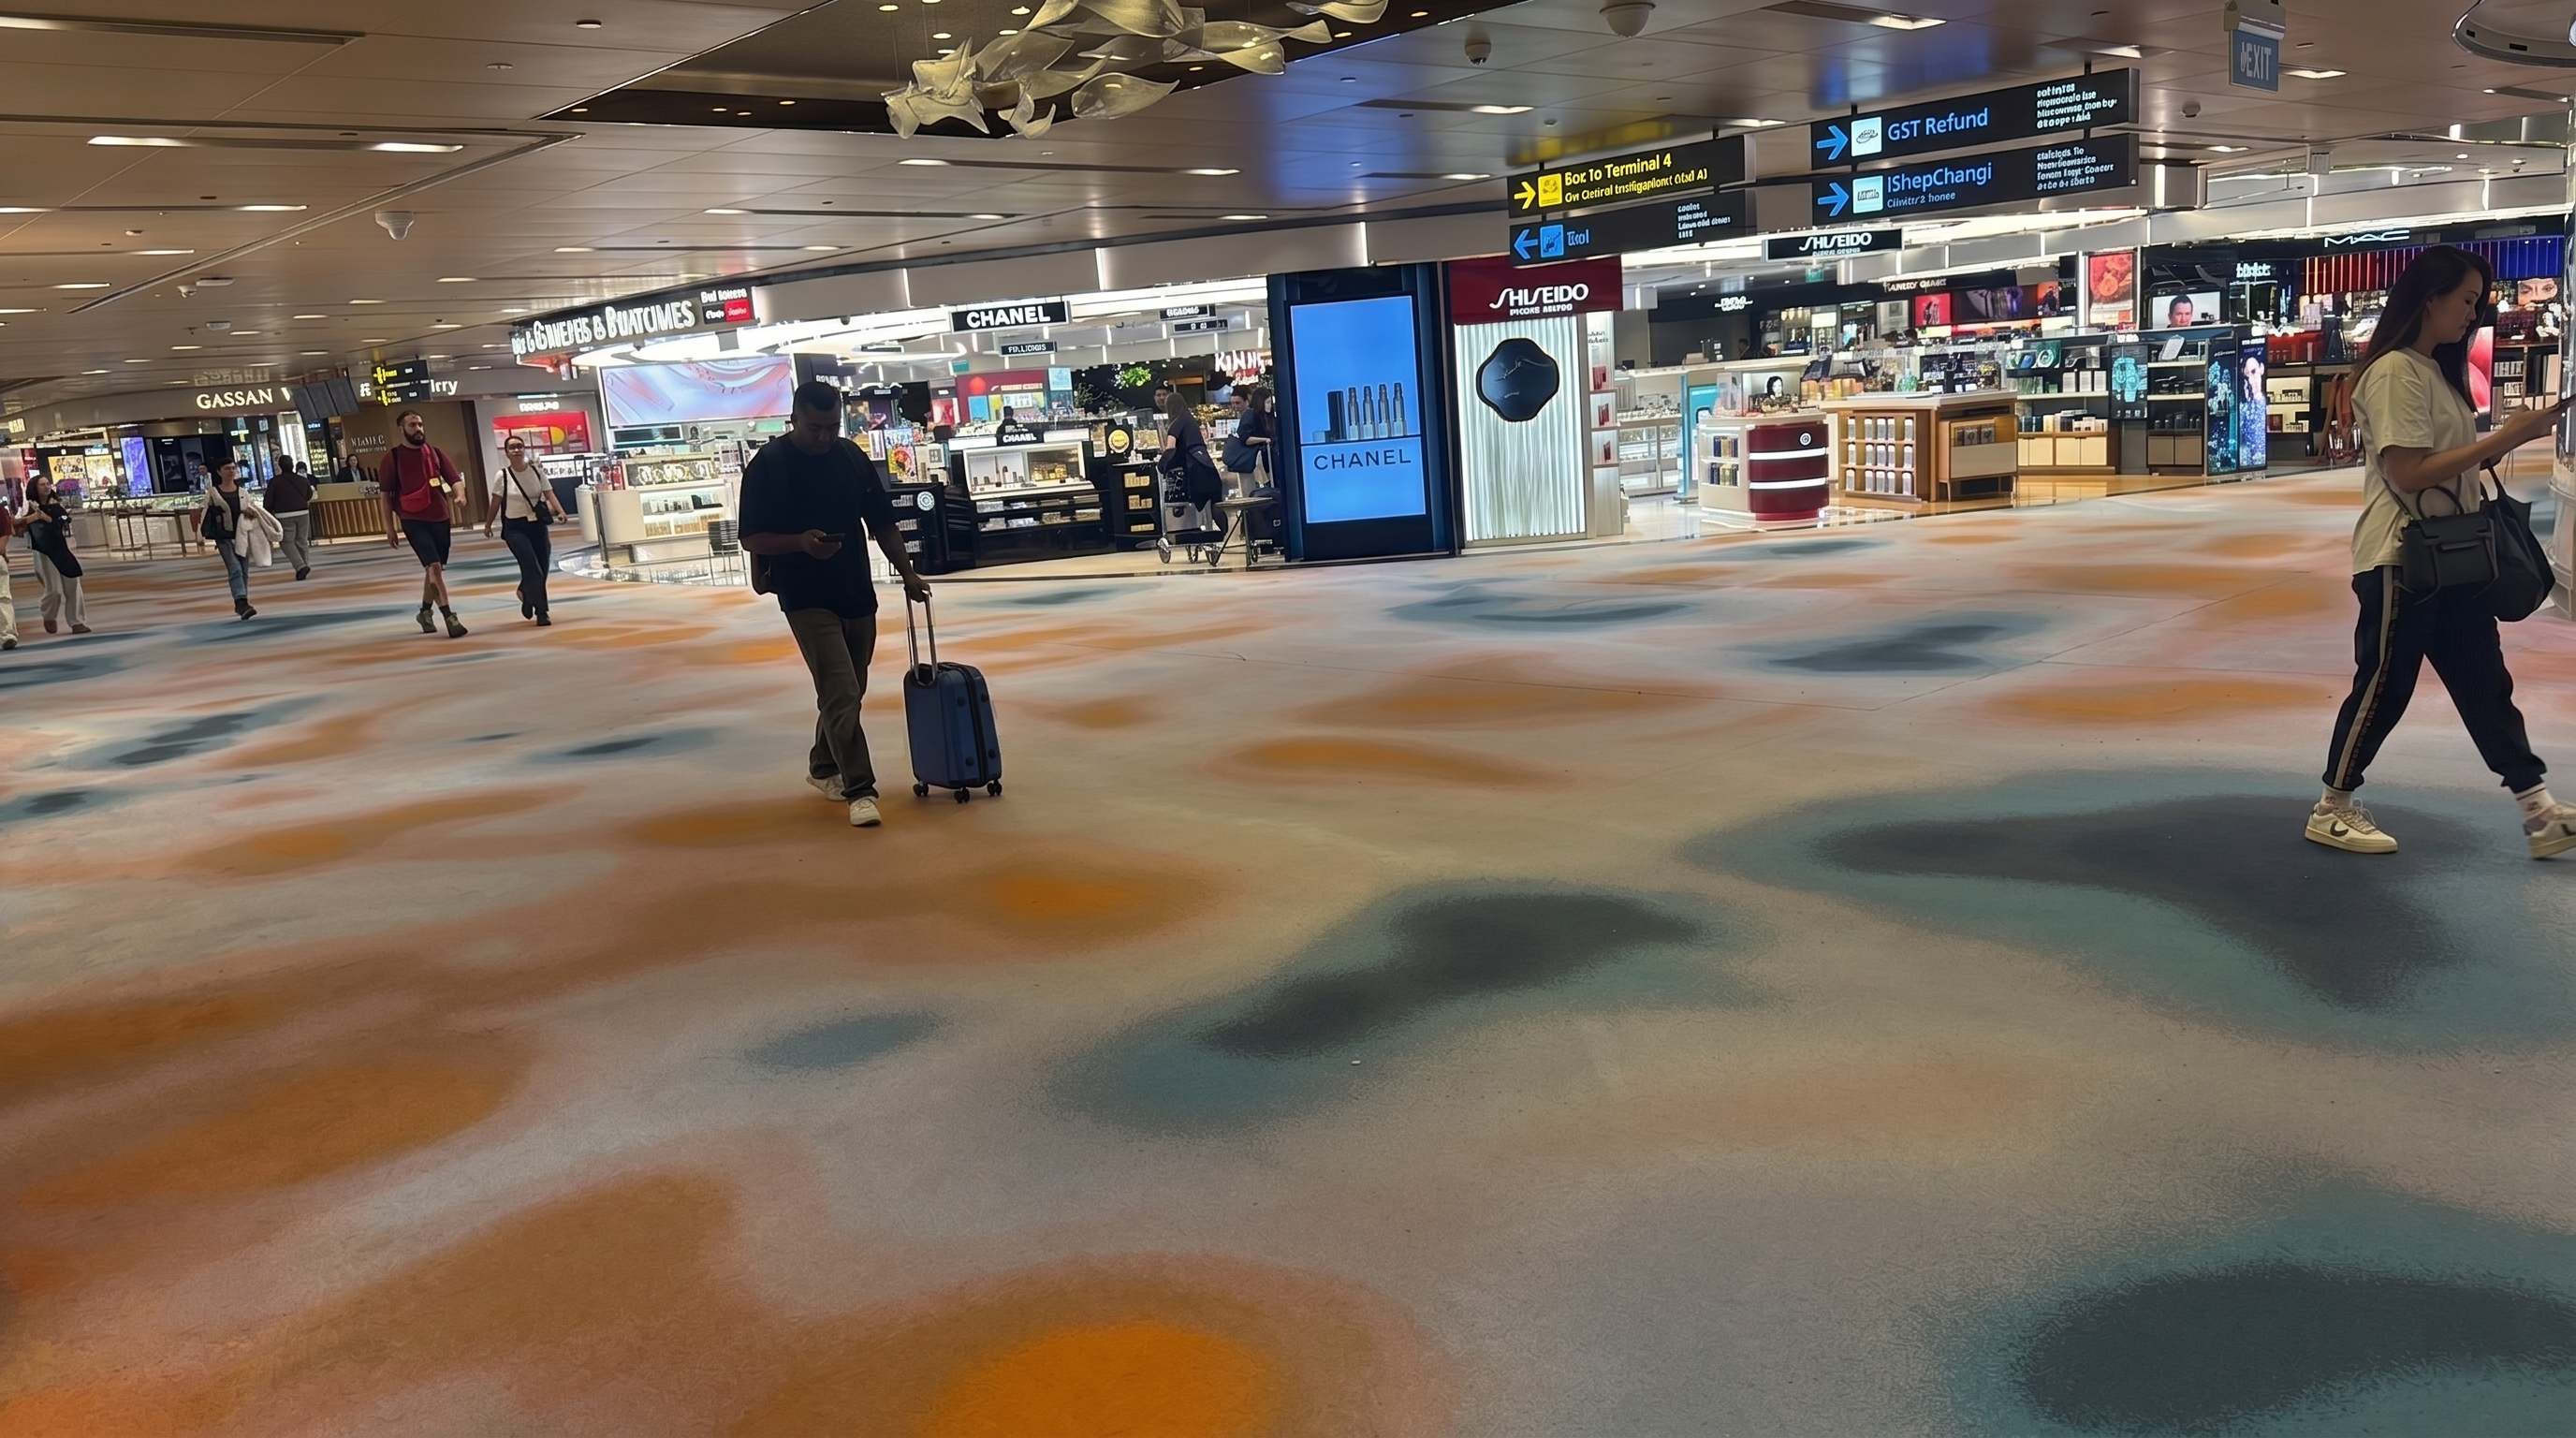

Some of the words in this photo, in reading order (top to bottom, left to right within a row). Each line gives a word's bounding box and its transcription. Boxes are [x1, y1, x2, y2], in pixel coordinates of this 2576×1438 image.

[2247, 42, 2272, 81] EXIT
[1887, 119, 1921, 141] GST
[1925, 107, 1988, 136] Refund
[1604, 154, 1661, 179] Terminal
[1662, 153, 1673, 168] 4
[1798, 232, 1872, 251] SHISEIDO
[2324, 229, 2410, 248] MAC
[1488, 283, 1589, 310] SHISEIDO
[966, 305, 1051, 329] CHANEL
[196, 388, 273, 410] GASSAN
[1313, 448, 1412, 471] CHANEL
